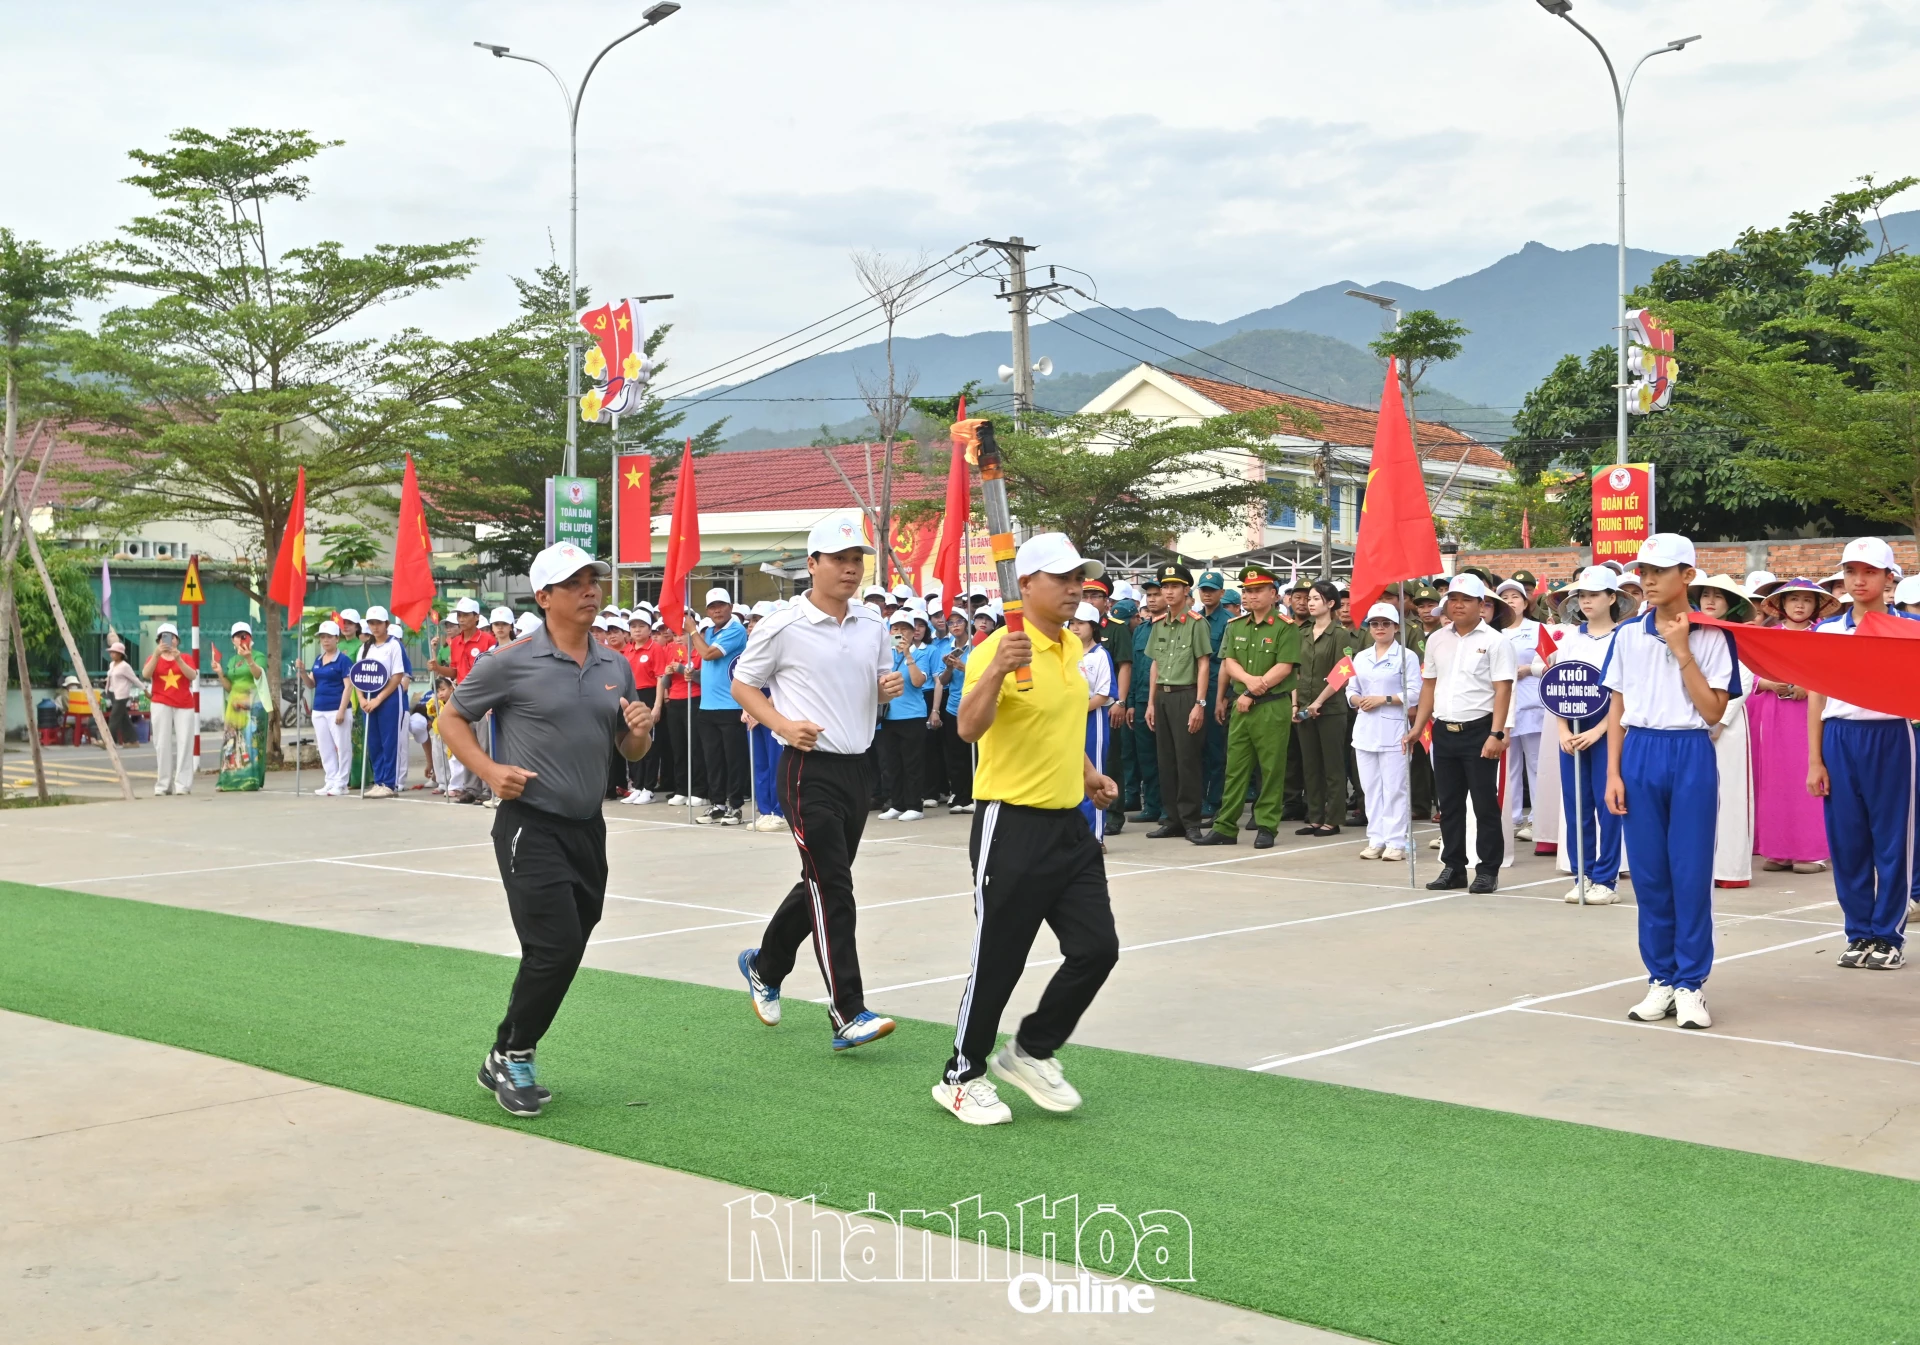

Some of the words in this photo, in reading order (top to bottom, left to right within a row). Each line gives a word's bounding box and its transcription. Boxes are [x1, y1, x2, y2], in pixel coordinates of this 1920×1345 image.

[1601, 494, 1622, 511] ĐOÀN
[1624, 492, 1639, 510] KẾT
[561, 506, 577, 518] TOÀN
[579, 507, 592, 518] DÂN
[574, 521, 593, 535] LUYỆN
[1597, 517, 1622, 531] TRUNG
[1624, 515, 1644, 533] THỰC
[1597, 540, 1612, 555] CAO
[962, 571, 977, 582] SNG
[362, 662, 378, 672] KHỐI
[1559, 666, 1587, 681] KHỐI
[1546, 683, 1558, 696] CÁN
[1558, 683, 1568, 699] BỘ,
[1568, 683, 1583, 697] CÔNG
[1584, 683, 1601, 698] CHỨC,
[1559, 700, 1571, 713] VIÊN
[1572, 700, 1587, 714] CHỨC
